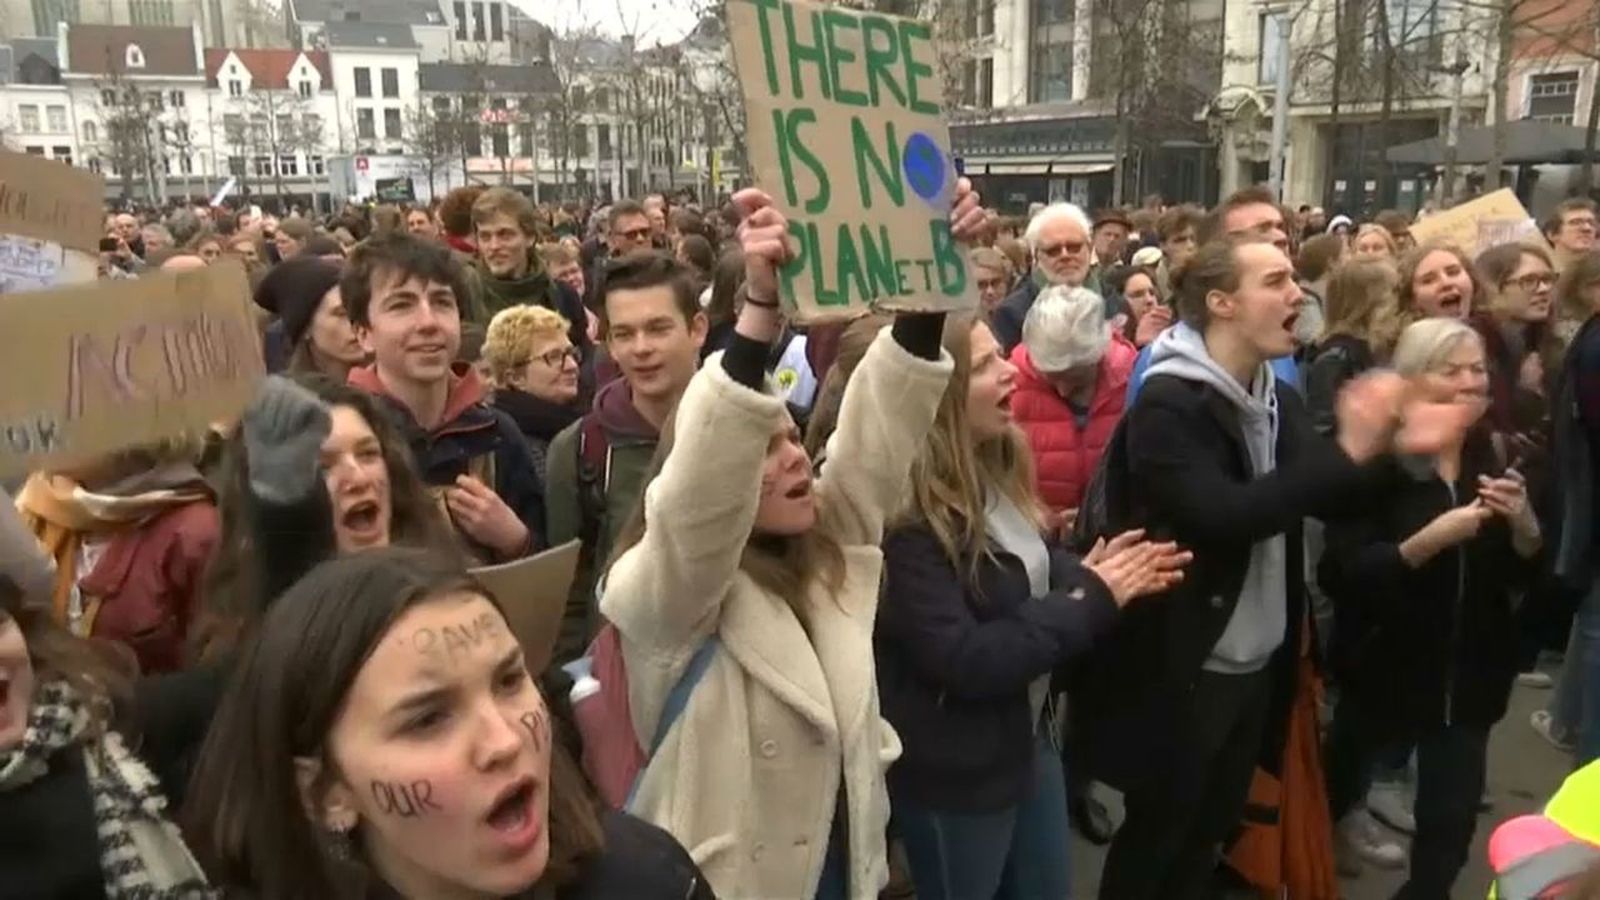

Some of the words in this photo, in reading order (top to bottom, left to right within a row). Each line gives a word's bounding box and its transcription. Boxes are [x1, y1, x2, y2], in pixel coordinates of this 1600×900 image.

[750, 0, 940, 114] THERE
[773, 109, 830, 214] IS
[930, 219, 966, 297] B
[371, 779, 443, 818] OUR
